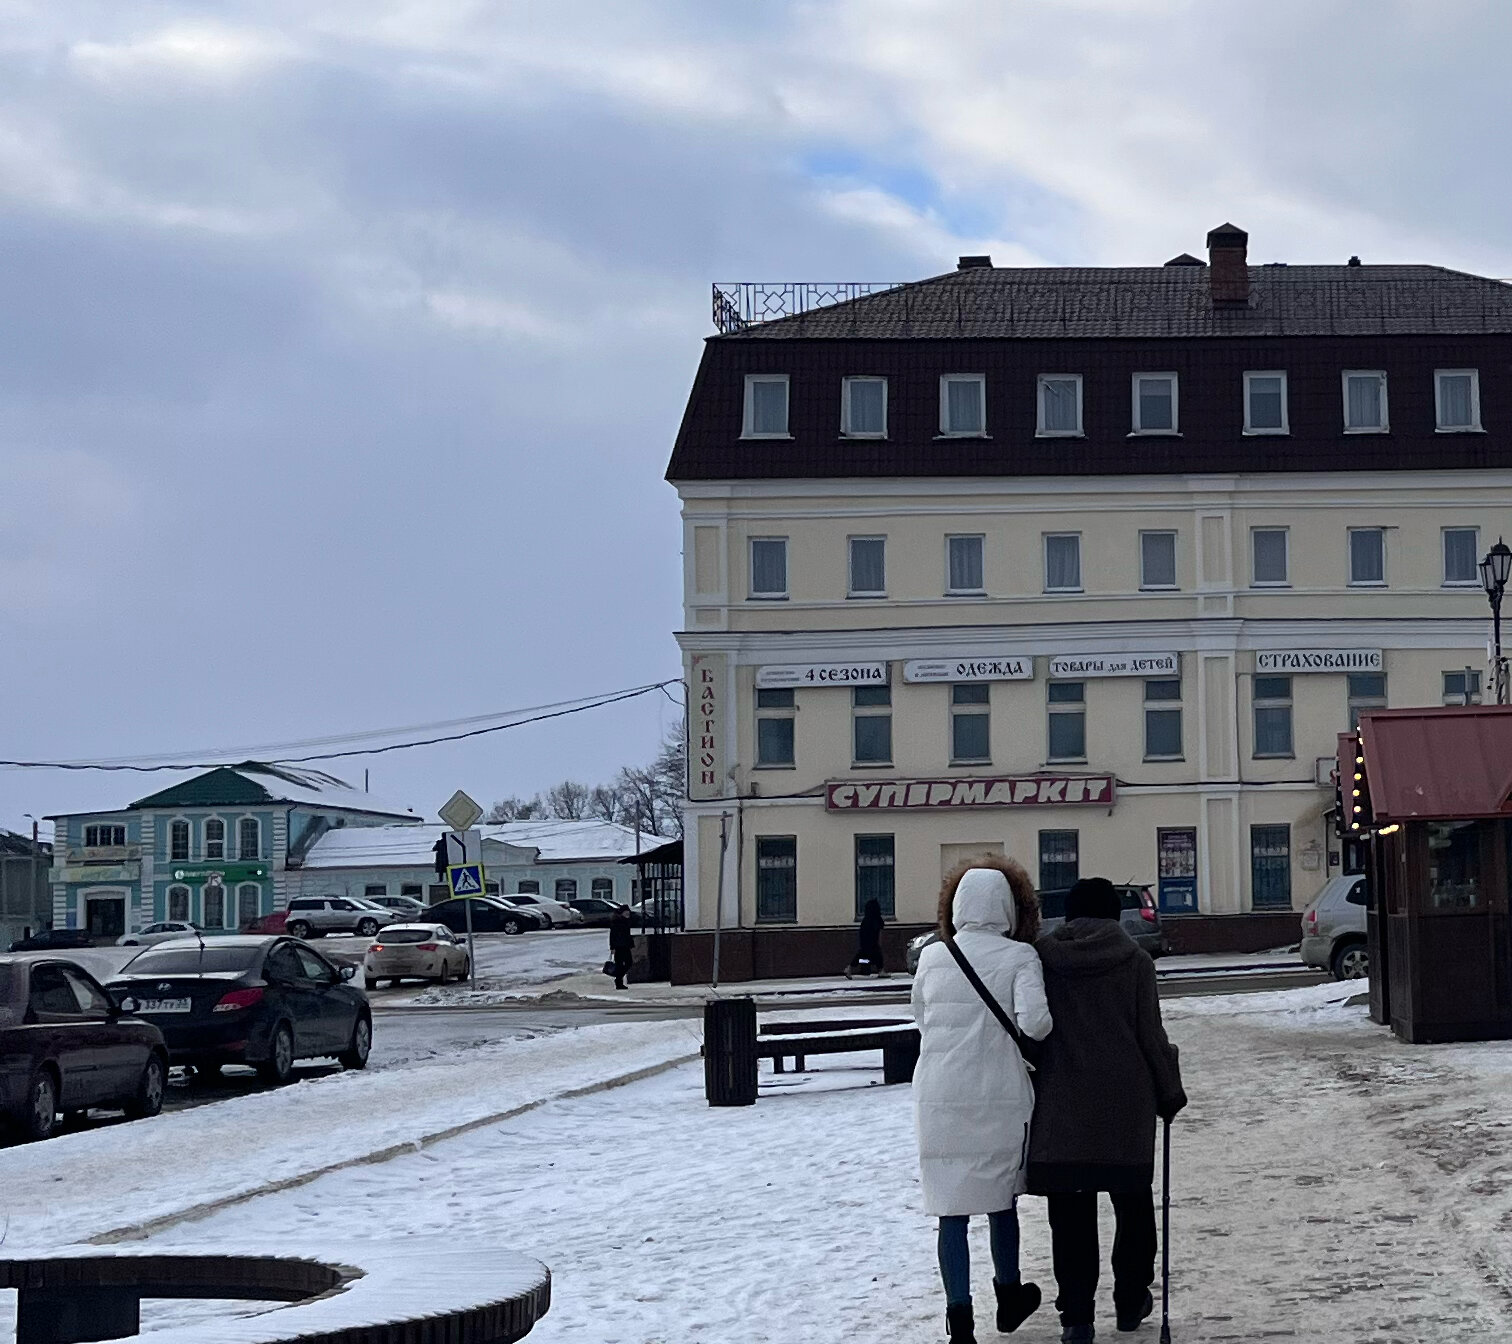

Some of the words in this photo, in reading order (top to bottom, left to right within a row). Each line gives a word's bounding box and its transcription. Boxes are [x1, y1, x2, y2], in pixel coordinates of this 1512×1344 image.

[1052, 660, 1103, 673] ТОВАРЫ
[1130, 658, 1174, 672] ДЕТЕЙ
[1258, 652, 1381, 668] СТРАХОВАНИЕ
[805, 669, 815, 681] 4
[819, 667, 882, 681] СЕЗОНА
[956, 661, 1024, 677] ОДЕЖДА
[700, 668, 715, 785] БАСТИОН
[831, 779, 1107, 808] СУПЕРМАРКЕТ
